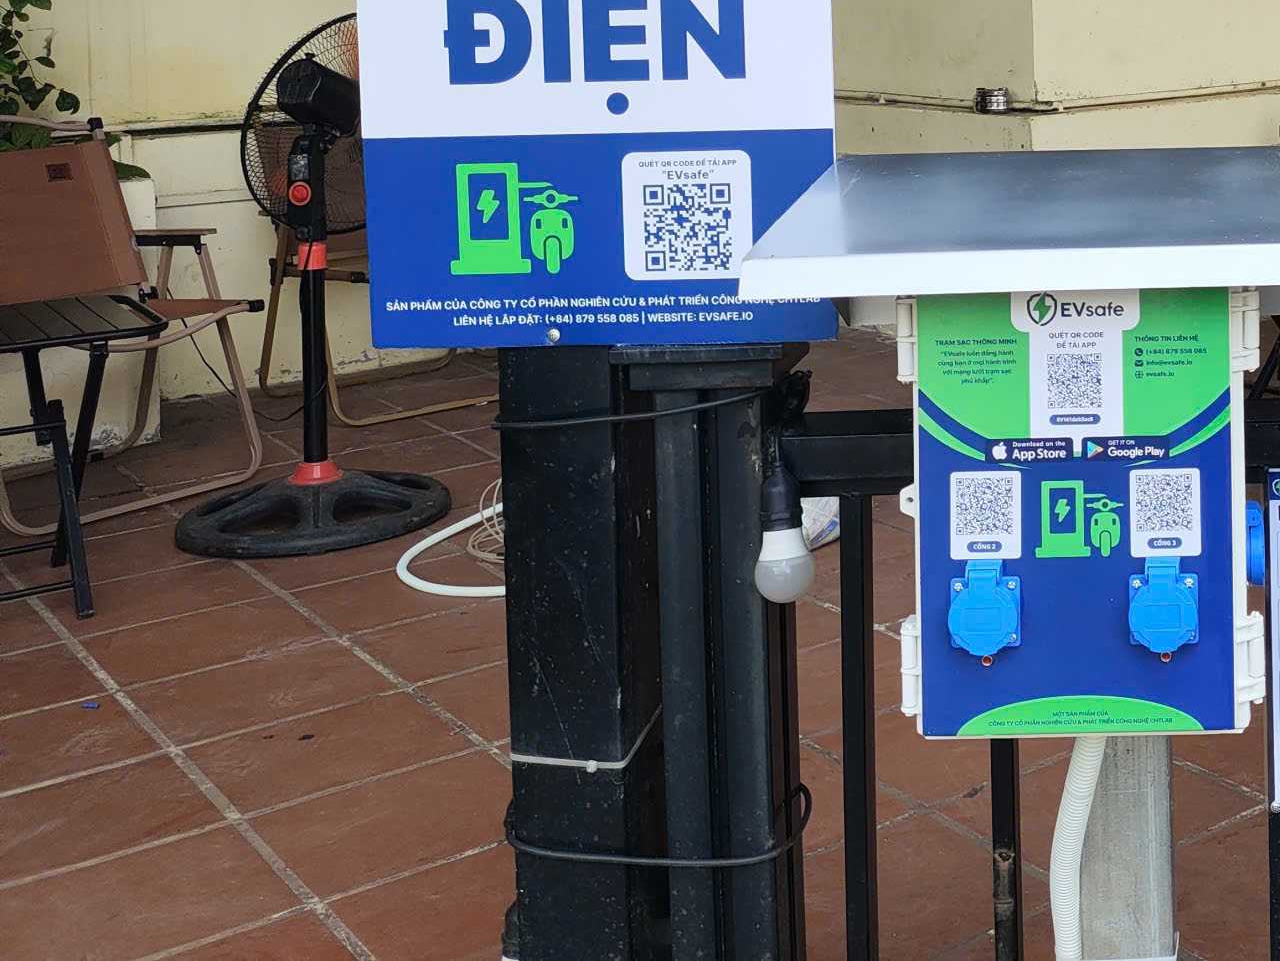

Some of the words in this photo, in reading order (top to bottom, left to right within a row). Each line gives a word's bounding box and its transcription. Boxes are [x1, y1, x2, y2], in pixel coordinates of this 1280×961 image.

[662, 170, 714, 180] "EVsafe"
[386, 299, 409, 311] SẢN
[410, 299, 442, 310] PHẨM
[444, 298, 467, 310] CỦA
[470, 298, 501, 309] CÔNG
[503, 299, 518, 309] TY
[520, 296, 537, 308] CỔ
[539, 296, 568, 308] PHẦN
[570, 295, 609, 307] NGHIÊN
[612, 295, 636, 307] CỨU
[639, 297, 646, 306] &
[648, 294, 677, 306] PHÁT
[678, 293, 708, 306] TRIỂN
[711, 293, 742, 305] CÔNG
[1060, 302, 1124, 318] EVsafe
[453, 314, 477, 326] LIÊN
[479, 314, 493, 327] HỆ
[495, 314, 516, 325] LẮP
[518, 313, 543, 326] ĐẶT:
[545, 314, 573, 325] (+84)
[575, 314, 595, 324] 879
[597, 314, 616, 323] 558
[618, 313, 639, 323] 085
[648, 313, 697, 323] WEBSITE:
[699, 311, 753, 322] EVSAFE.IO
[1012, 449, 1036, 461] App
[1036, 448, 1067, 459] Store
[1108, 447, 1143, 459] Google
[1145, 446, 1165, 458] Play
